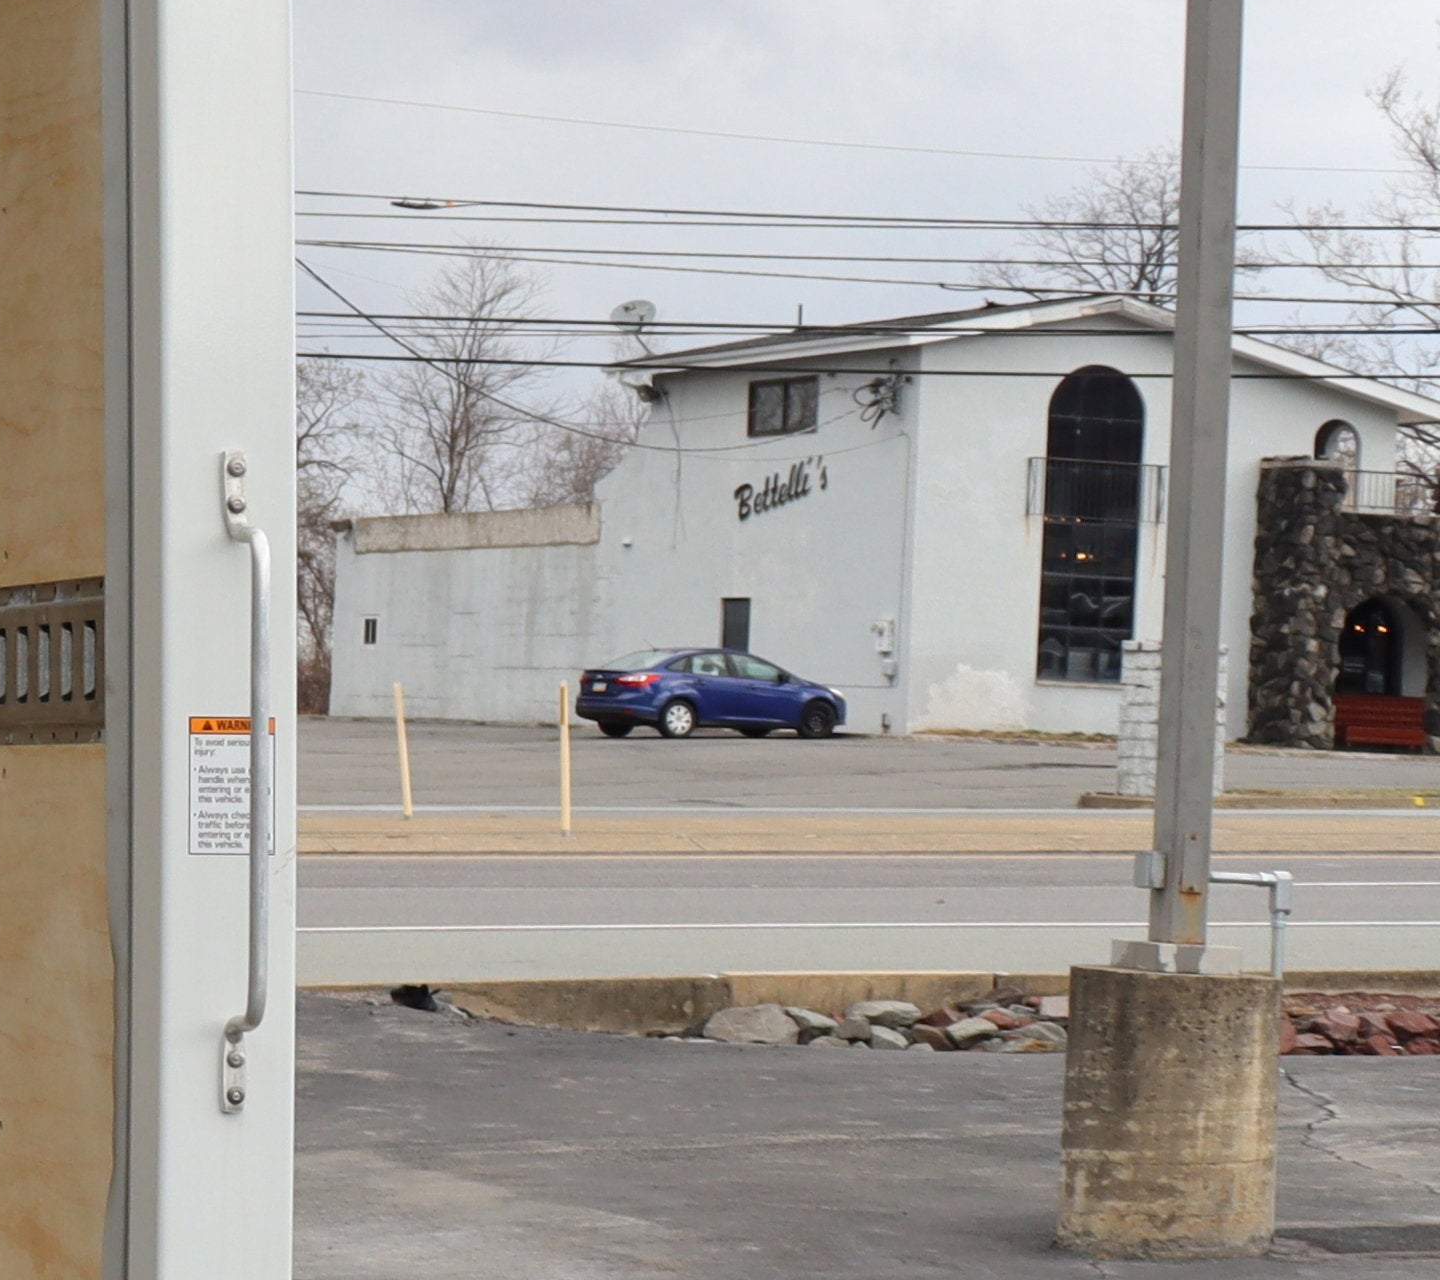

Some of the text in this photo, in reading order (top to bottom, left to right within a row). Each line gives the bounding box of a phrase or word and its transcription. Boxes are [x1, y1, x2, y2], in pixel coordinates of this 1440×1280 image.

[217, 720, 252, 730] WARNI
[194, 737, 203, 746] To
[198, 765, 229, 775] Always
[231, 767, 246, 775] use
[198, 776, 225, 784] handle
[198, 785, 231, 796] entering
[198, 795, 213, 804] this
[198, 810, 251, 820] Always chec
[198, 821, 222, 829] traffic
[198, 830, 231, 841] entering
[198, 840, 213, 849] this
